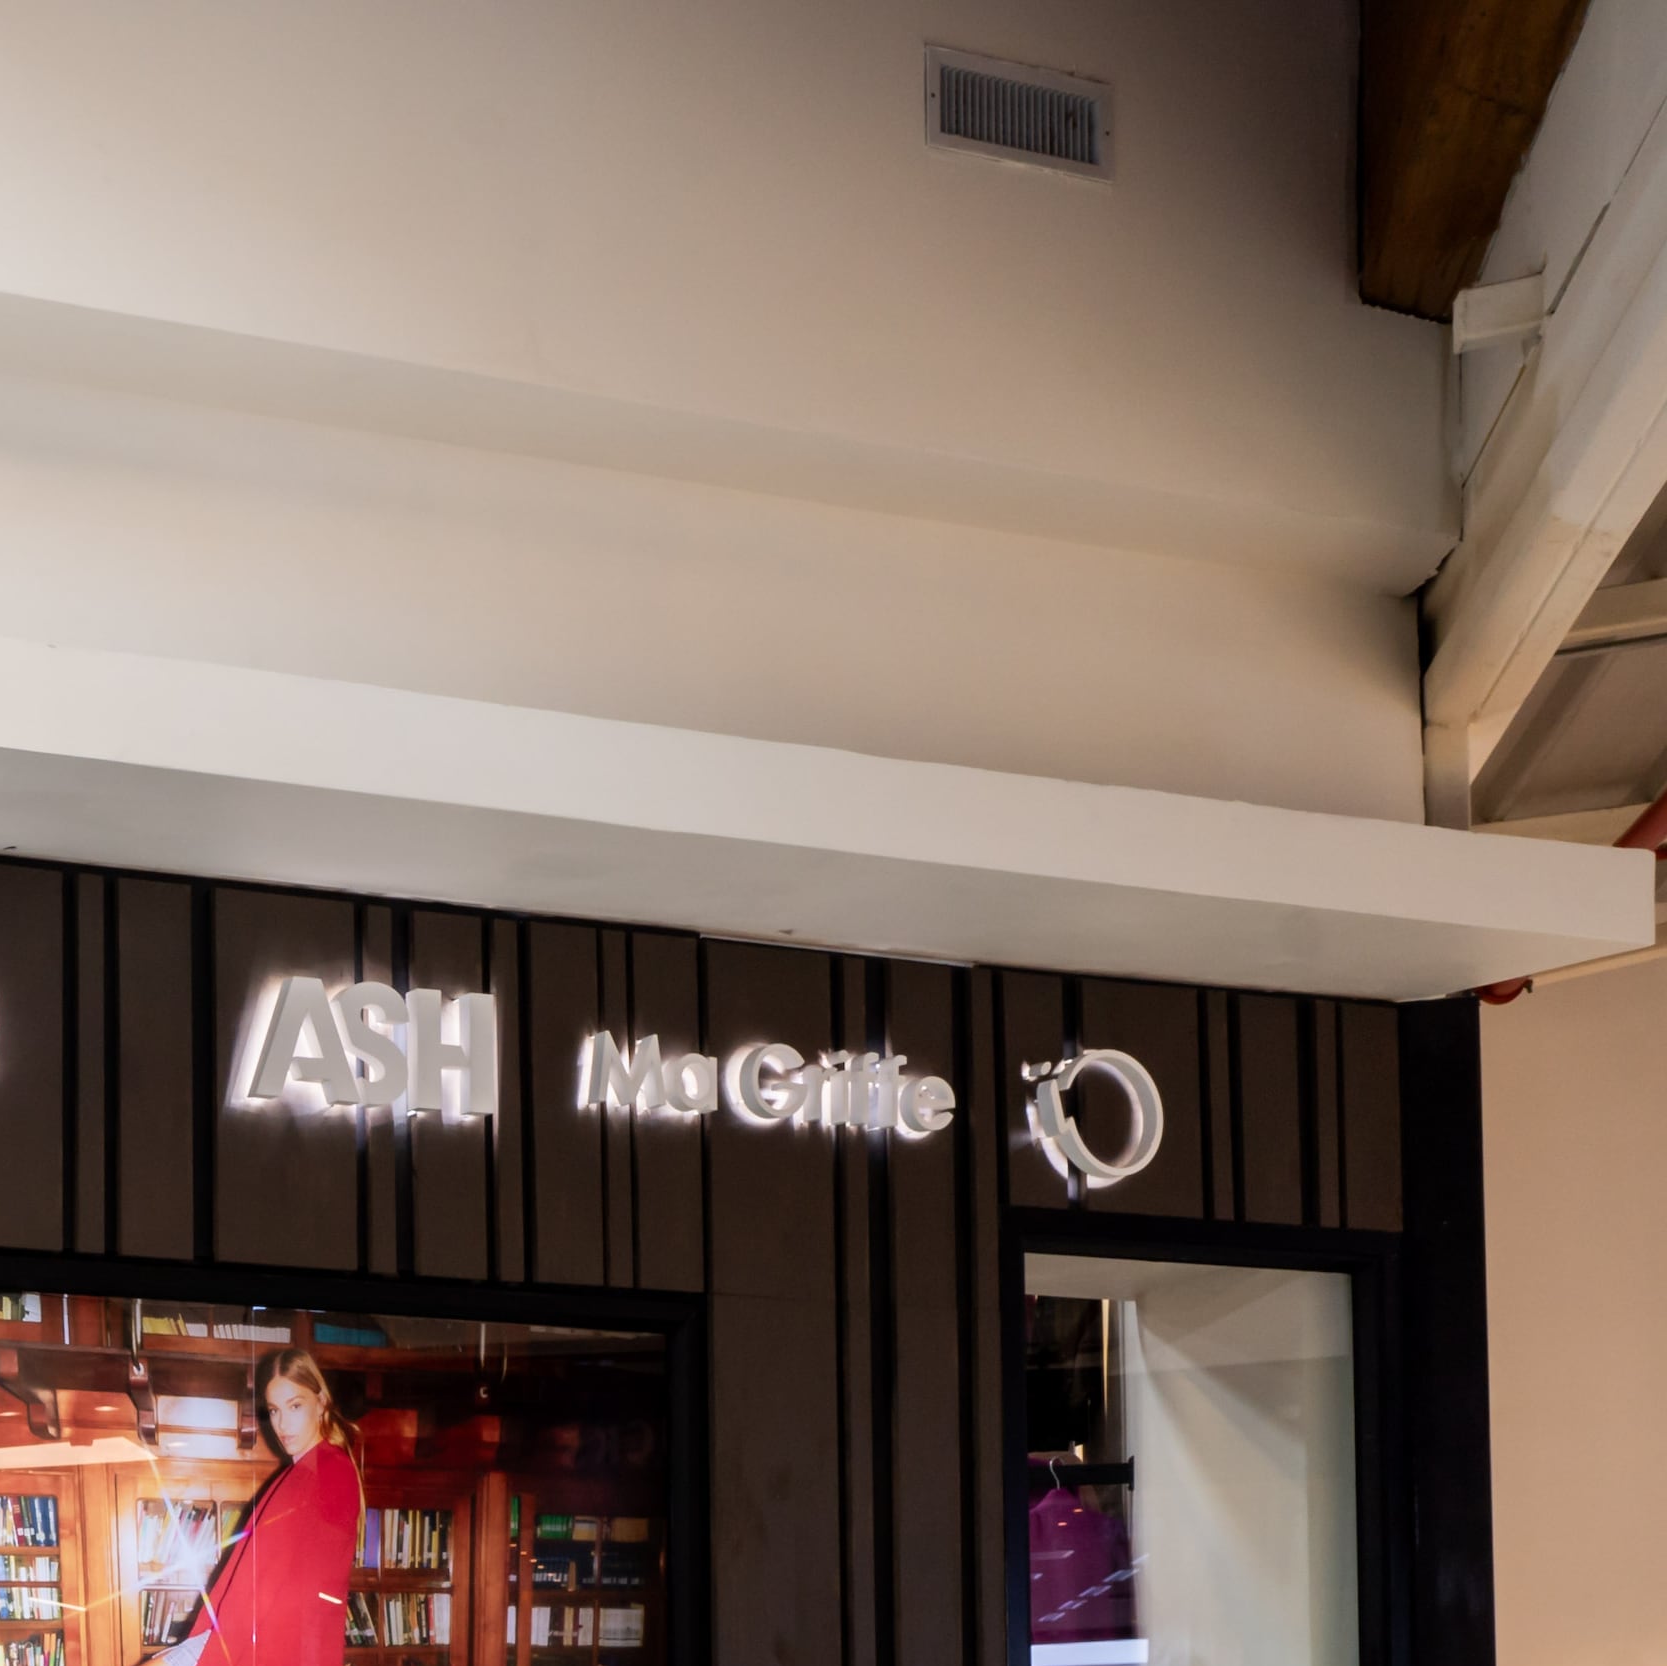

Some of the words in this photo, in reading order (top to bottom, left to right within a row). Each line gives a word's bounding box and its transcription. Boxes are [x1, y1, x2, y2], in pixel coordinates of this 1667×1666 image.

[248, 976, 496, 1115] ASH
[587, 1029, 719, 1114] Ma
[739, 1043, 957, 1132] Griffe
